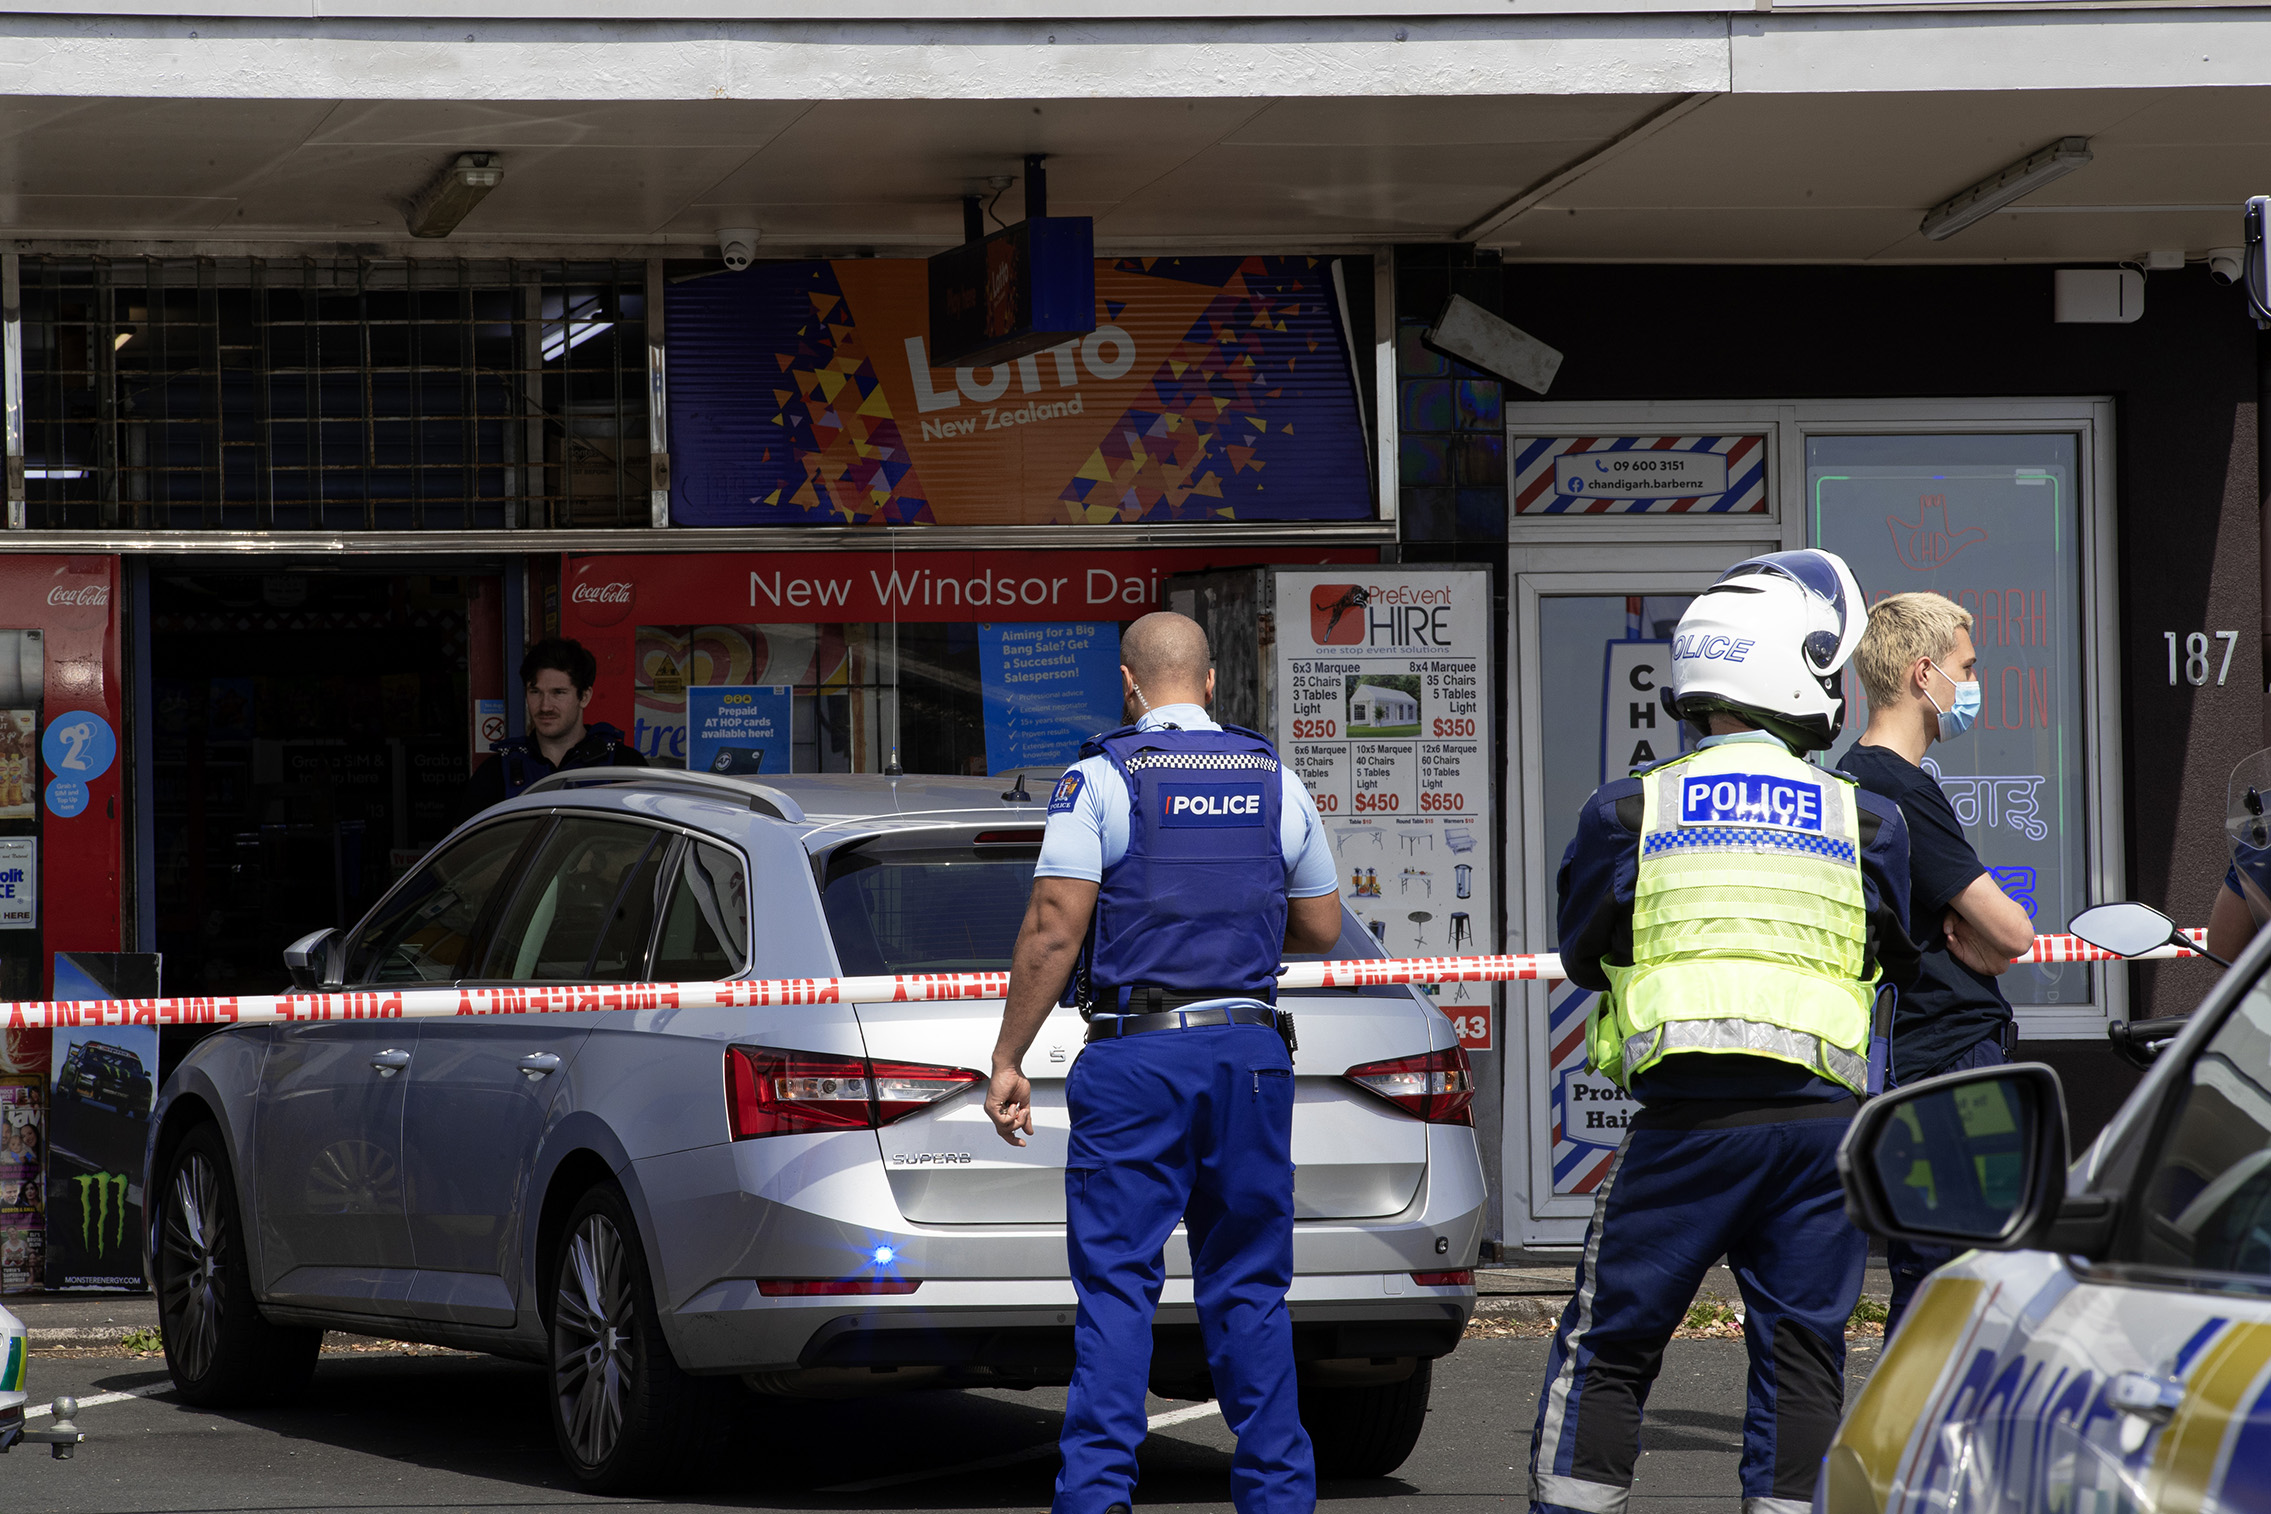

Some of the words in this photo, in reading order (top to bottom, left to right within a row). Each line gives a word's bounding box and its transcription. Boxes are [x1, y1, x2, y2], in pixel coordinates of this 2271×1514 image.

[920, 417, 976, 441] New
[981, 393, 1084, 430] Zealand
[1613, 461, 1630, 472] 09
[1632, 461, 1657, 472] 600
[1660, 461, 1684, 471] 3151
[1588, 479, 1703, 492] chandigarh.barbernz
[571, 582, 633, 603] Coca-Cola
[750, 571, 852, 606] New
[870, 569, 1069, 606] Windsor
[1086, 568, 1158, 604] Dai
[47, 585, 110, 606] Coca-Cola
[1368, 586, 1452, 605] PreEvent
[1369, 606, 1452, 646] HIRE
[1002, 630, 1044, 642] Aiming
[1046, 628, 1063, 638] for
[1066, 628, 1074, 636] a
[1076, 625, 1095, 636] Big
[1002, 644, 1033, 656] Bang
[1035, 640, 1066, 652] Sale?
[1068, 639, 1089, 650] Get
[1340, 646, 1364, 655] stop
[1400, 646, 1450, 654] solutions
[1673, 635, 1755, 663] OLICE
[1004, 661, 1011, 670] a
[1013, 654, 1076, 669] Successful
[2164, 630, 2239, 686] 187
[1292, 662, 1312, 674] 6x3
[1314, 662, 1360, 675] Marquee
[1409, 662, 1428, 672] 8x4
[1431, 662, 1476, 674] Marquee
[1004, 668, 1080, 684] Salesperson!
[1293, 676, 1306, 687] 25
[1308, 676, 1342, 687] Chairs
[1426, 676, 1439, 686] 35
[1443, 675, 1476, 686] Chairs
[1019, 690, 1061, 701] Professional
[1062, 690, 1084, 698] advice
[1293, 690, 1300, 700] 3
[1302, 690, 1338, 700] Tables
[1433, 689, 1440, 699] 5
[1442, 688, 1476, 699] Tables
[718, 706, 758, 716] Prepaid
[1020, 704, 1051, 714] Excellent
[1052, 702, 1088, 712] negotiator
[1294, 703, 1321, 716] Light
[1450, 702, 1476, 714] Light
[704, 718, 718, 728] AT
[720, 718, 742, 728] HOP
[744, 718, 771, 728] cards
[1035, 717, 1053, 726] years
[1054, 714, 1092, 724] experience
[1022, 730, 1046, 738] Proven
[1047, 728, 1070, 736] results
[1292, 718, 1336, 738] $250
[1432, 716, 1476, 738] $350
[702, 728, 746, 739] available
[748, 728, 774, 738] here!
[1022, 741, 1055, 750] Extensive
[1056, 740, 1080, 748] market
[1294, 746, 1310, 755] 6x6
[1312, 746, 1347, 756] Marquee
[1356, 745, 1376, 754] 10x5
[1378, 745, 1412, 755] Marquee
[1422, 745, 1440, 754] 12x6
[1443, 745, 1477, 754] Marquee
[1023, 750, 1061, 760] knowledge
[1422, 756, 1432, 765] 60
[1433, 756, 1460, 765] Chairs
[1295, 758, 1305, 766] 35
[1307, 757, 1334, 766] Chairs
[1356, 757, 1366, 765] 40
[1368, 757, 1395, 766] Chairs
[1303, 769, 1329, 778] Tables
[1364, 768, 1390, 777] Tables
[1422, 768, 1432, 776] 10
[1434, 768, 1460, 776] Tables
[1304, 780, 1316, 790] ght
[1357, 780, 1378, 790] Light
[1422, 779, 1443, 790] Light
[1173, 795, 1260, 815] POLICE
[1316, 794, 1338, 812] 50
[1355, 791, 1399, 813] $450
[1420, 790, 1464, 812] $650
[1688, 782, 1818, 820] POLICE
[4, 912, 30, 920] HERE
[891, 971, 1012, 1002] GENCY
[1586, 1109, 1632, 1128] Hai
[892, 1152, 972, 1165] SUPERB
[64, 1276, 141, 1285] MONSTERENERGY.COM
